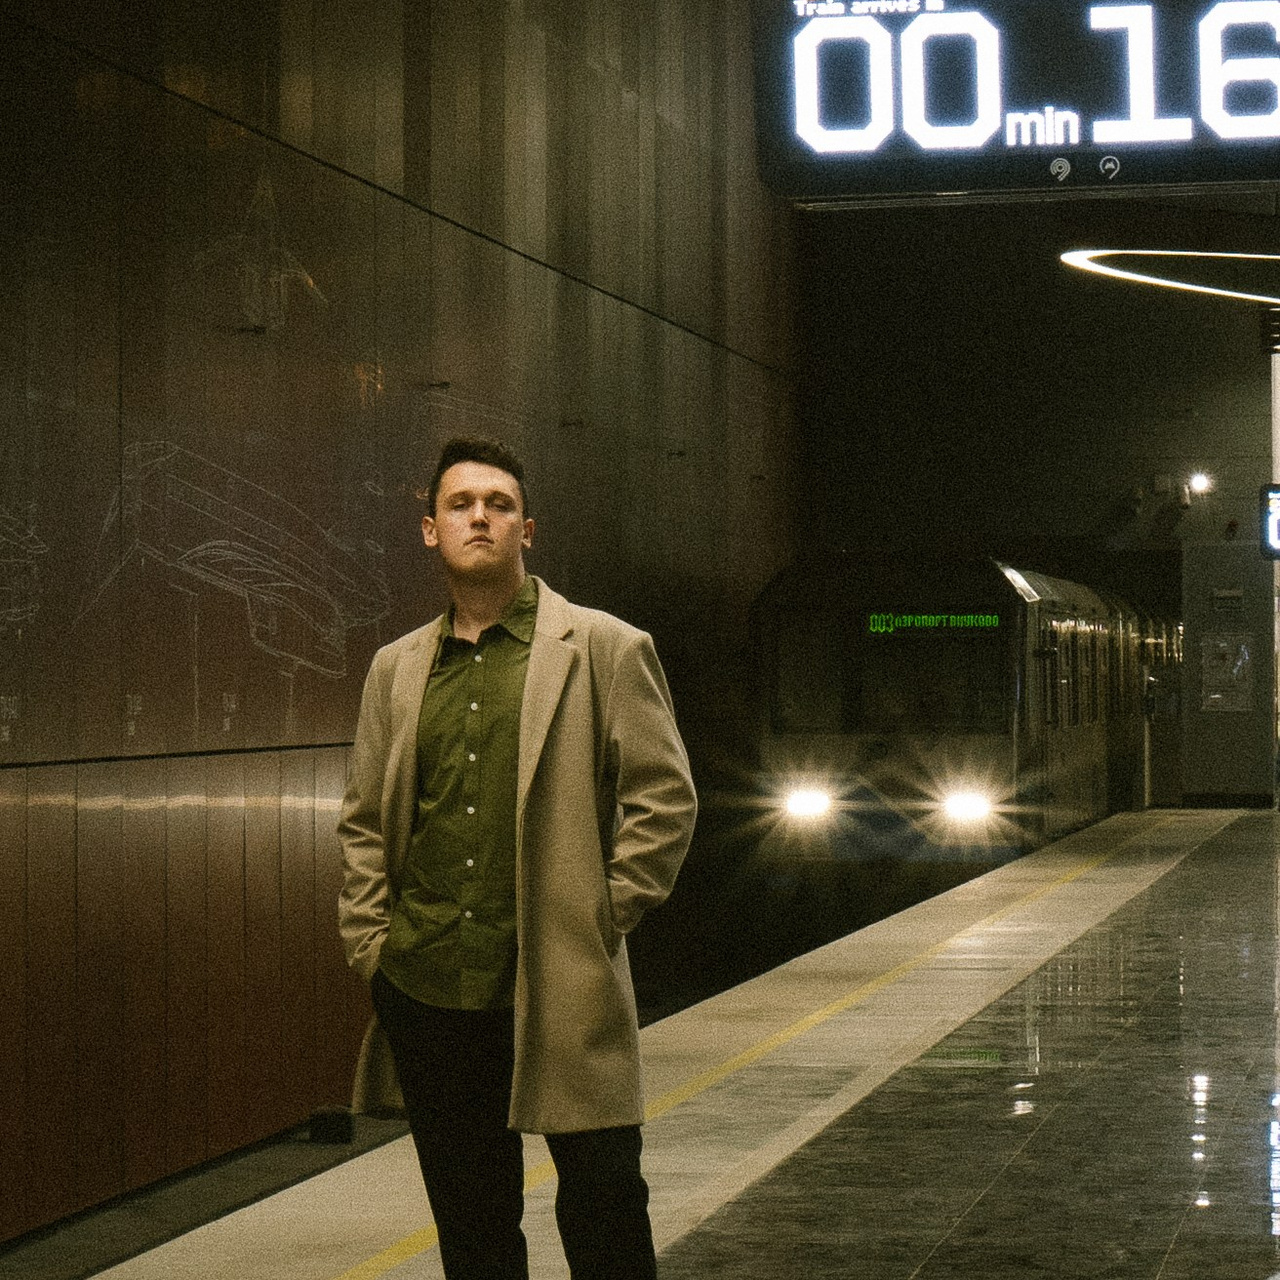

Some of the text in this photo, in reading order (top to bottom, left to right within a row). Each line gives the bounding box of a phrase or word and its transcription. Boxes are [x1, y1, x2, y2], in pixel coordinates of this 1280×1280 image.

[793, 0, 845, 16] Train
[793, 0, 1280, 153] 00 min 16
